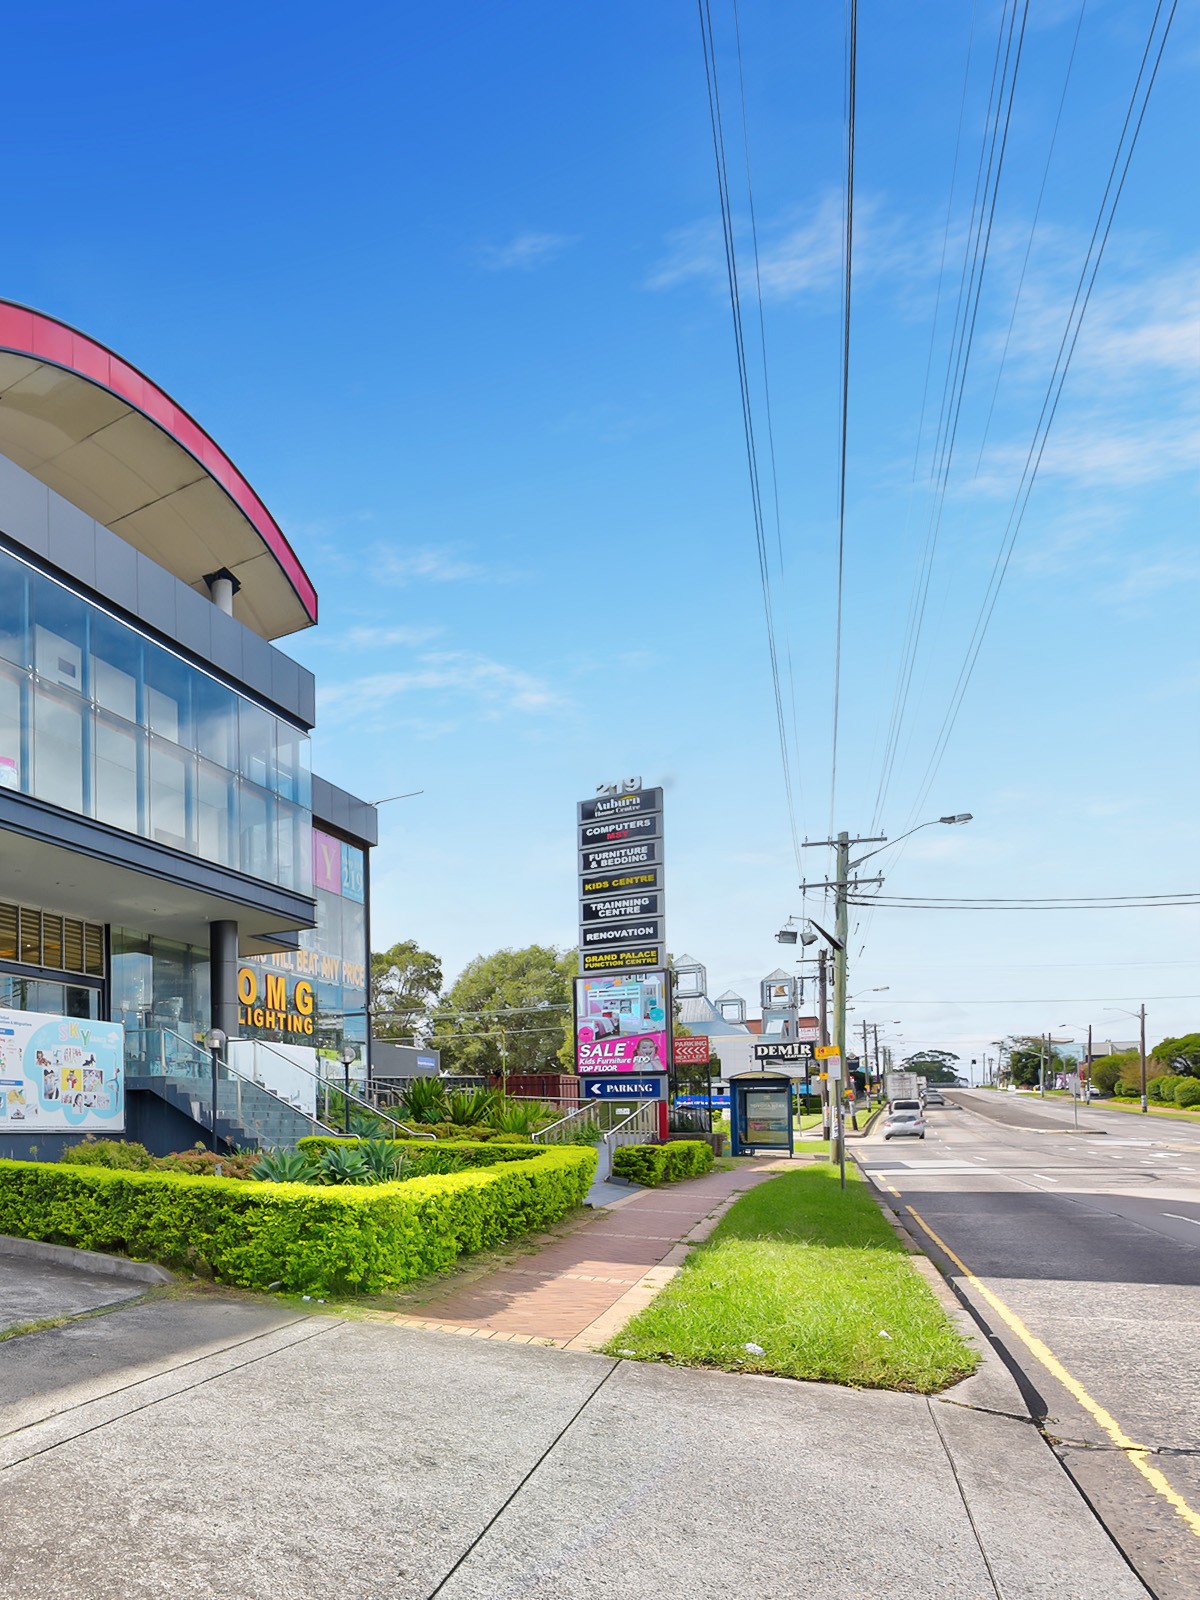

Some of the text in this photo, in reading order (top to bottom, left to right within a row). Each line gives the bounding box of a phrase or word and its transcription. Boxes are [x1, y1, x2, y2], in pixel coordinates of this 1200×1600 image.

[596, 776, 642, 797] 219
[594, 797, 640, 812] Auburn
[586, 819, 651, 836] COMPUTERS
[589, 846, 648, 861] FURNITURE
[601, 854, 647, 867] BEDDING
[343, 866, 363, 892] 219
[585, 874, 654, 891] KIDS CENTRE
[590, 897, 650, 911] TRAINNING
[598, 906, 641, 917] CENTRE
[586, 926, 654, 941] RENOVATION
[584, 957, 657, 969] FUNCTION CENTRE
[585, 950, 657, 963] GRAND PALACE
[296, 950, 318, 976] BEAT
[321, 956, 340, 981] ANY
[342, 961, 365, 988] PRICE
[237, 1006, 314, 1035] LIGHTING
[59, 1022, 91, 1046] SKY
[580, 1042, 627, 1058] SALE
[675, 1040, 707, 1048] PARKING
[606, 1084, 653, 1093] PARKING
